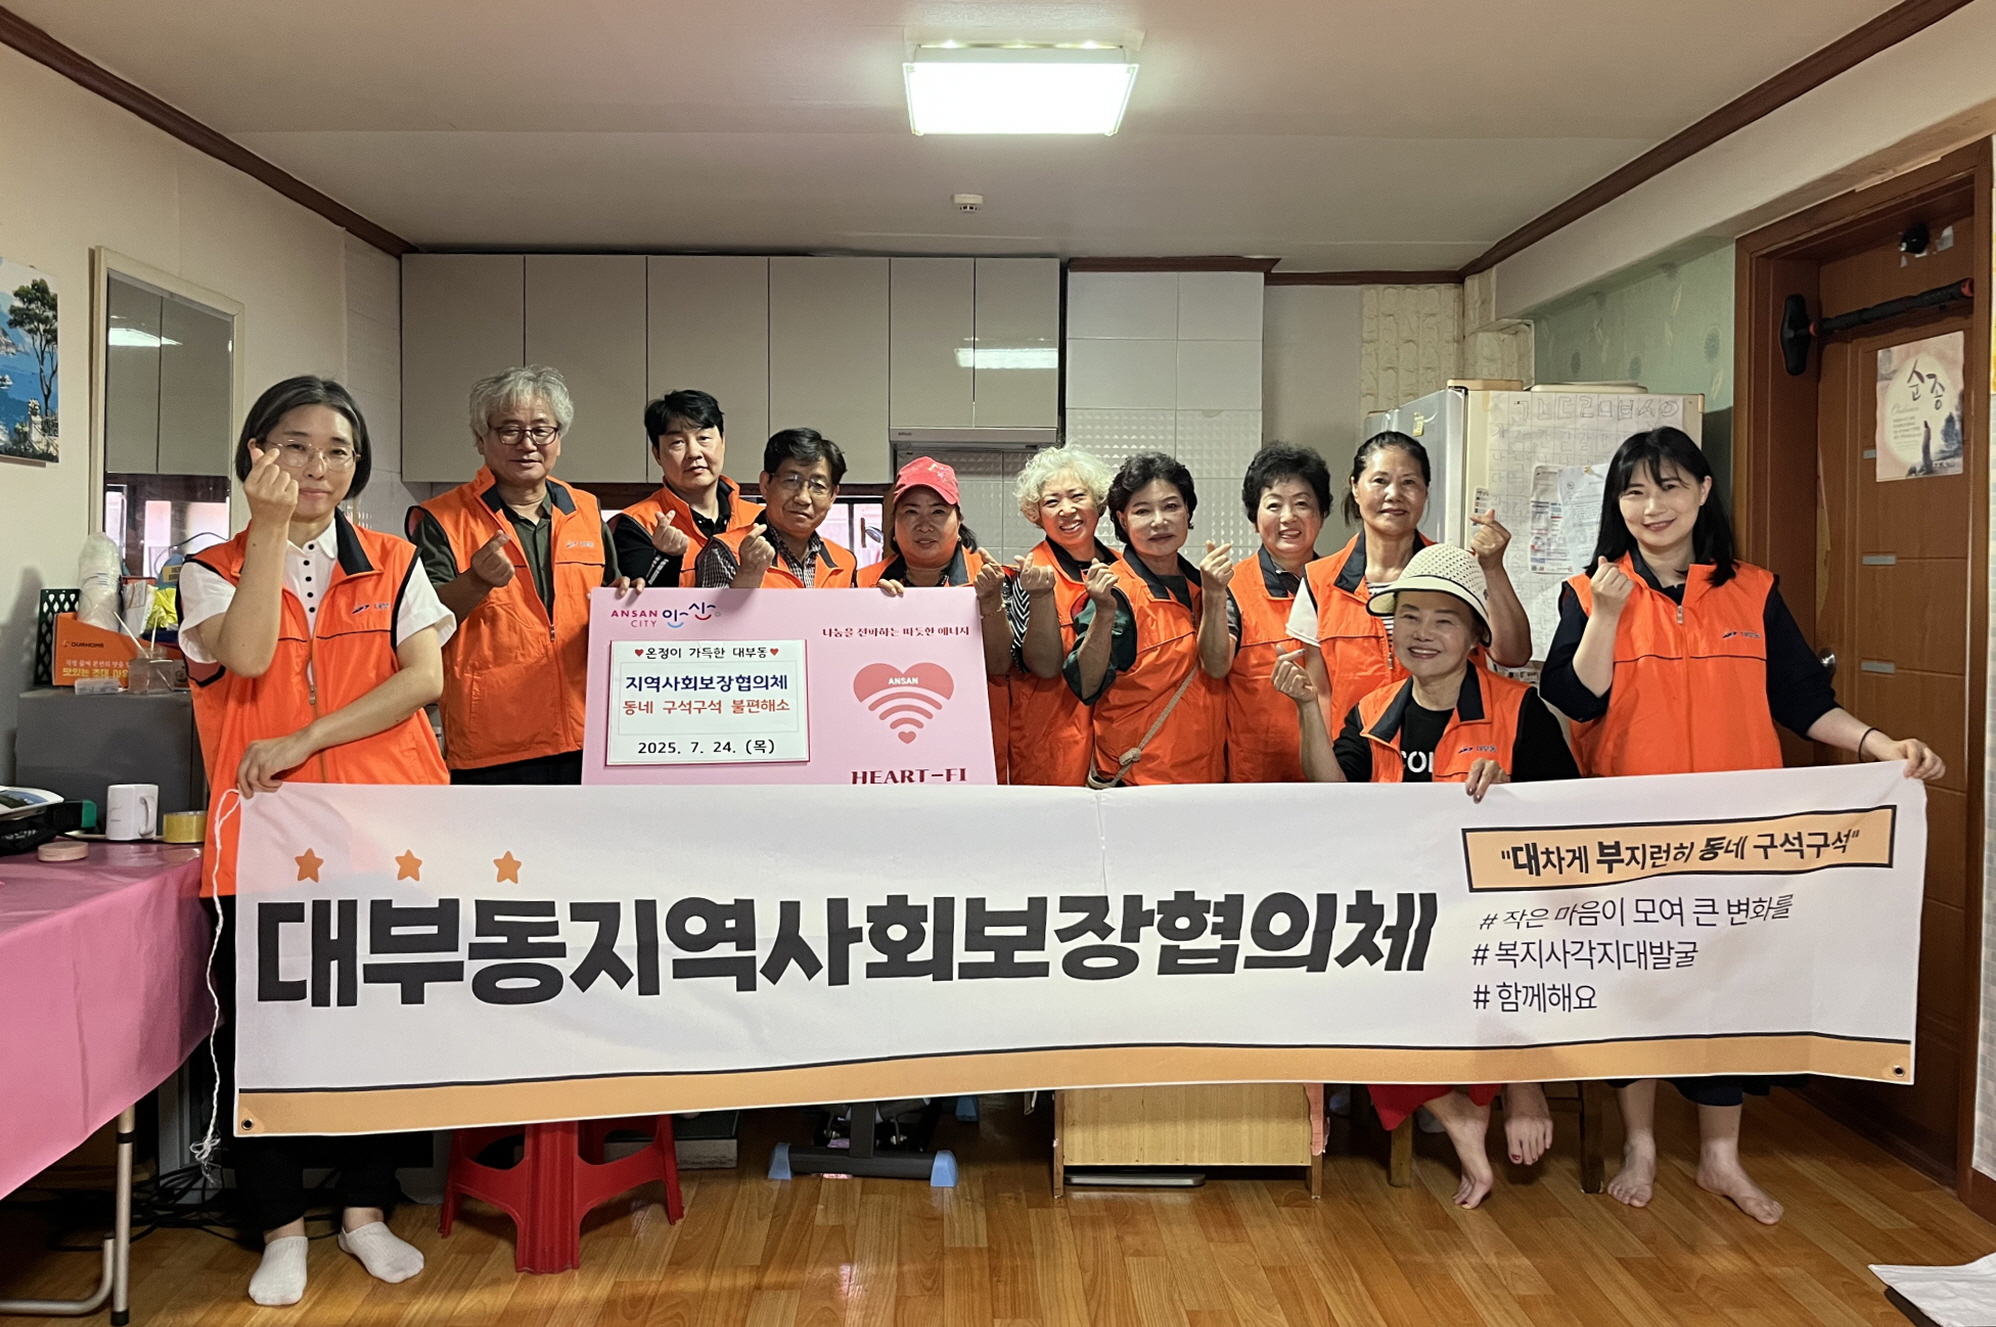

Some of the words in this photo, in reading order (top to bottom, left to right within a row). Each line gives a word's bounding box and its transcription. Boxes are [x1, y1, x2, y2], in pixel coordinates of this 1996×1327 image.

[610, 609, 658, 618] ANSAN
[630, 620, 657, 628] CITY
[822, 628, 854, 638] 나눔을
[937, 626, 970, 636] 에너지
[645, 646, 682, 660] 온정이
[689, 646, 726, 659] 가득한
[732, 646, 767, 659] 대부동
[625, 674, 788, 693] 지역사회보장협의체
[888, 677, 919, 686] ANSAN
[622, 700, 654, 716] 동네
[662, 699, 722, 716] 구석구석
[731, 698, 790, 715] 불편해소
[637, 741, 681, 755] 2025.
[690, 741, 704, 754] 7.
[713, 741, 736, 754] 24.
[745, 738, 775, 755] (목)
[851, 767, 967, 785] HEART-FI
[1596, 840, 1695, 869] 부지런히
[1698, 835, 1749, 862] 동네
[1503, 908, 1550, 930] 작은
[1554, 897, 1626, 928] 마음이
[1633, 896, 1685, 928] 모여
[1692, 897, 1720, 927] 큰
[1726, 894, 1795, 926] 변화를
[257, 889, 1438, 1008] 대부동지역사회보장협의체
[1495, 938, 1699, 971] 복지사각지대발굴
[1496, 981, 1598, 1014] 함께해요
